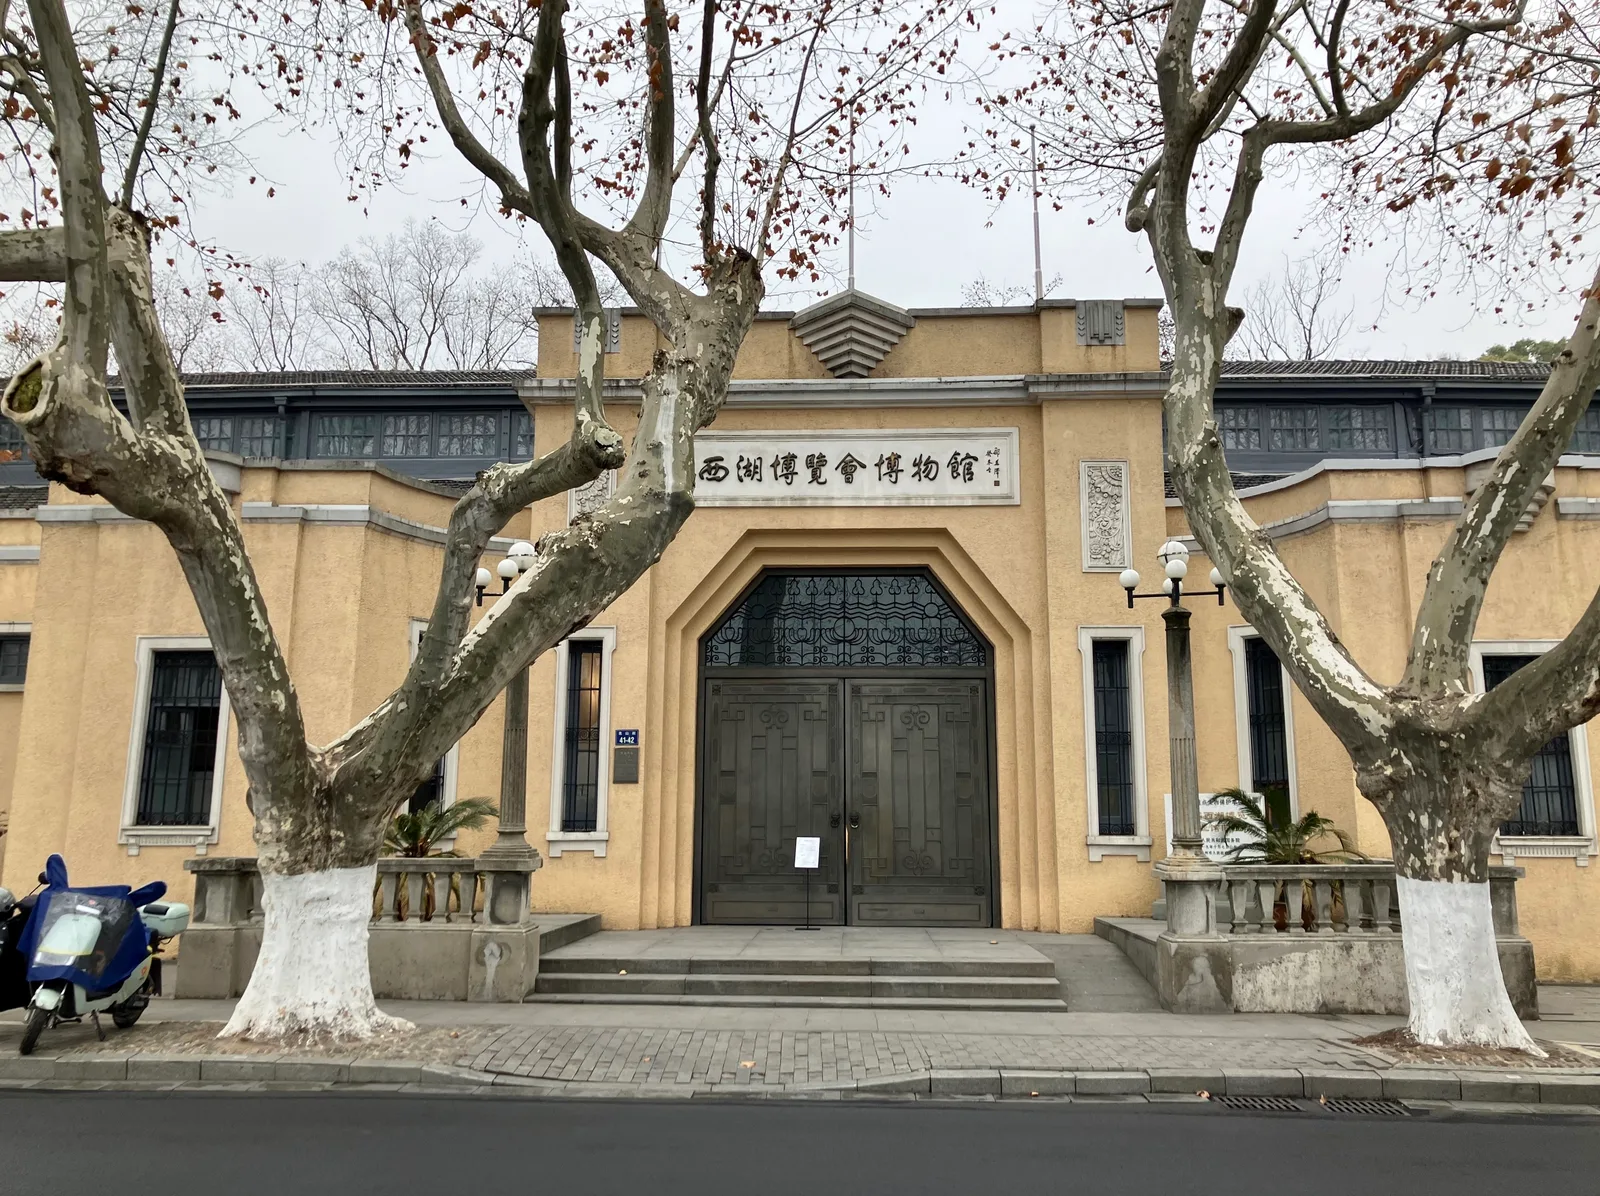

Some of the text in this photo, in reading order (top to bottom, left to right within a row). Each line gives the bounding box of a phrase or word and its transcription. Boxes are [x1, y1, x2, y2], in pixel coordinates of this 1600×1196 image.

[698, 451, 979, 485] 西湖博覽會博物館
[619, 736, 635, 744] 41-42
